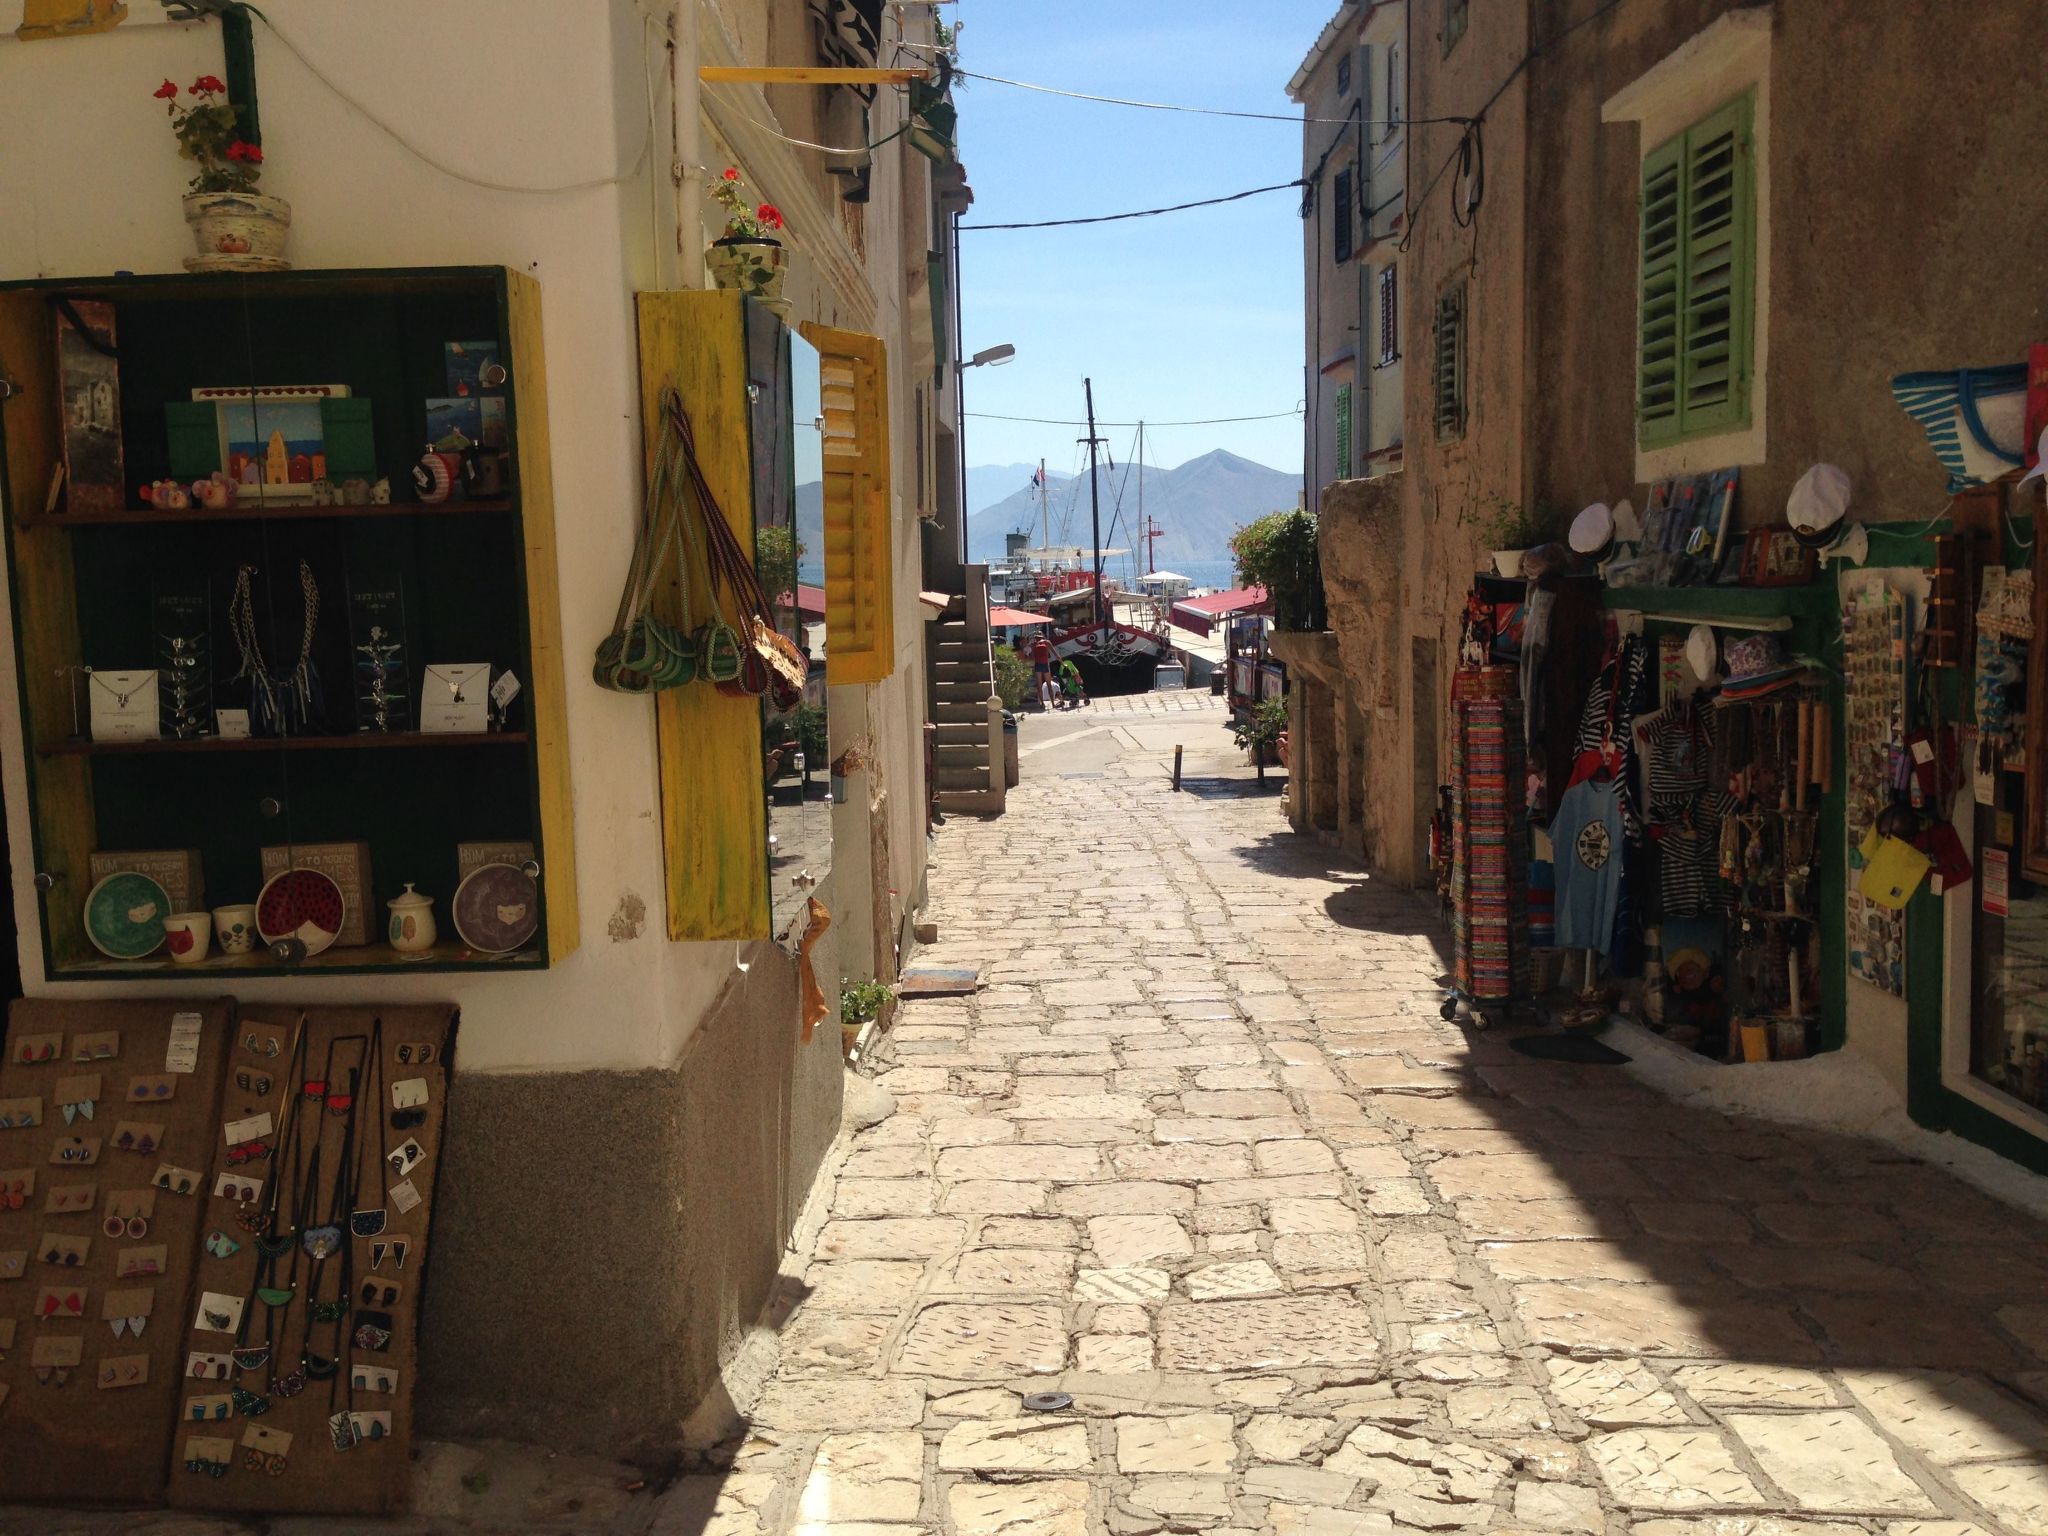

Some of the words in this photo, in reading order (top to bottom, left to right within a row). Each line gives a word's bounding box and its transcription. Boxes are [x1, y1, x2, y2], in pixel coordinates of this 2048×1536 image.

[306, 855, 321, 865] TO
[502, 854, 517, 865] TO
[136, 863, 150, 872] TO
